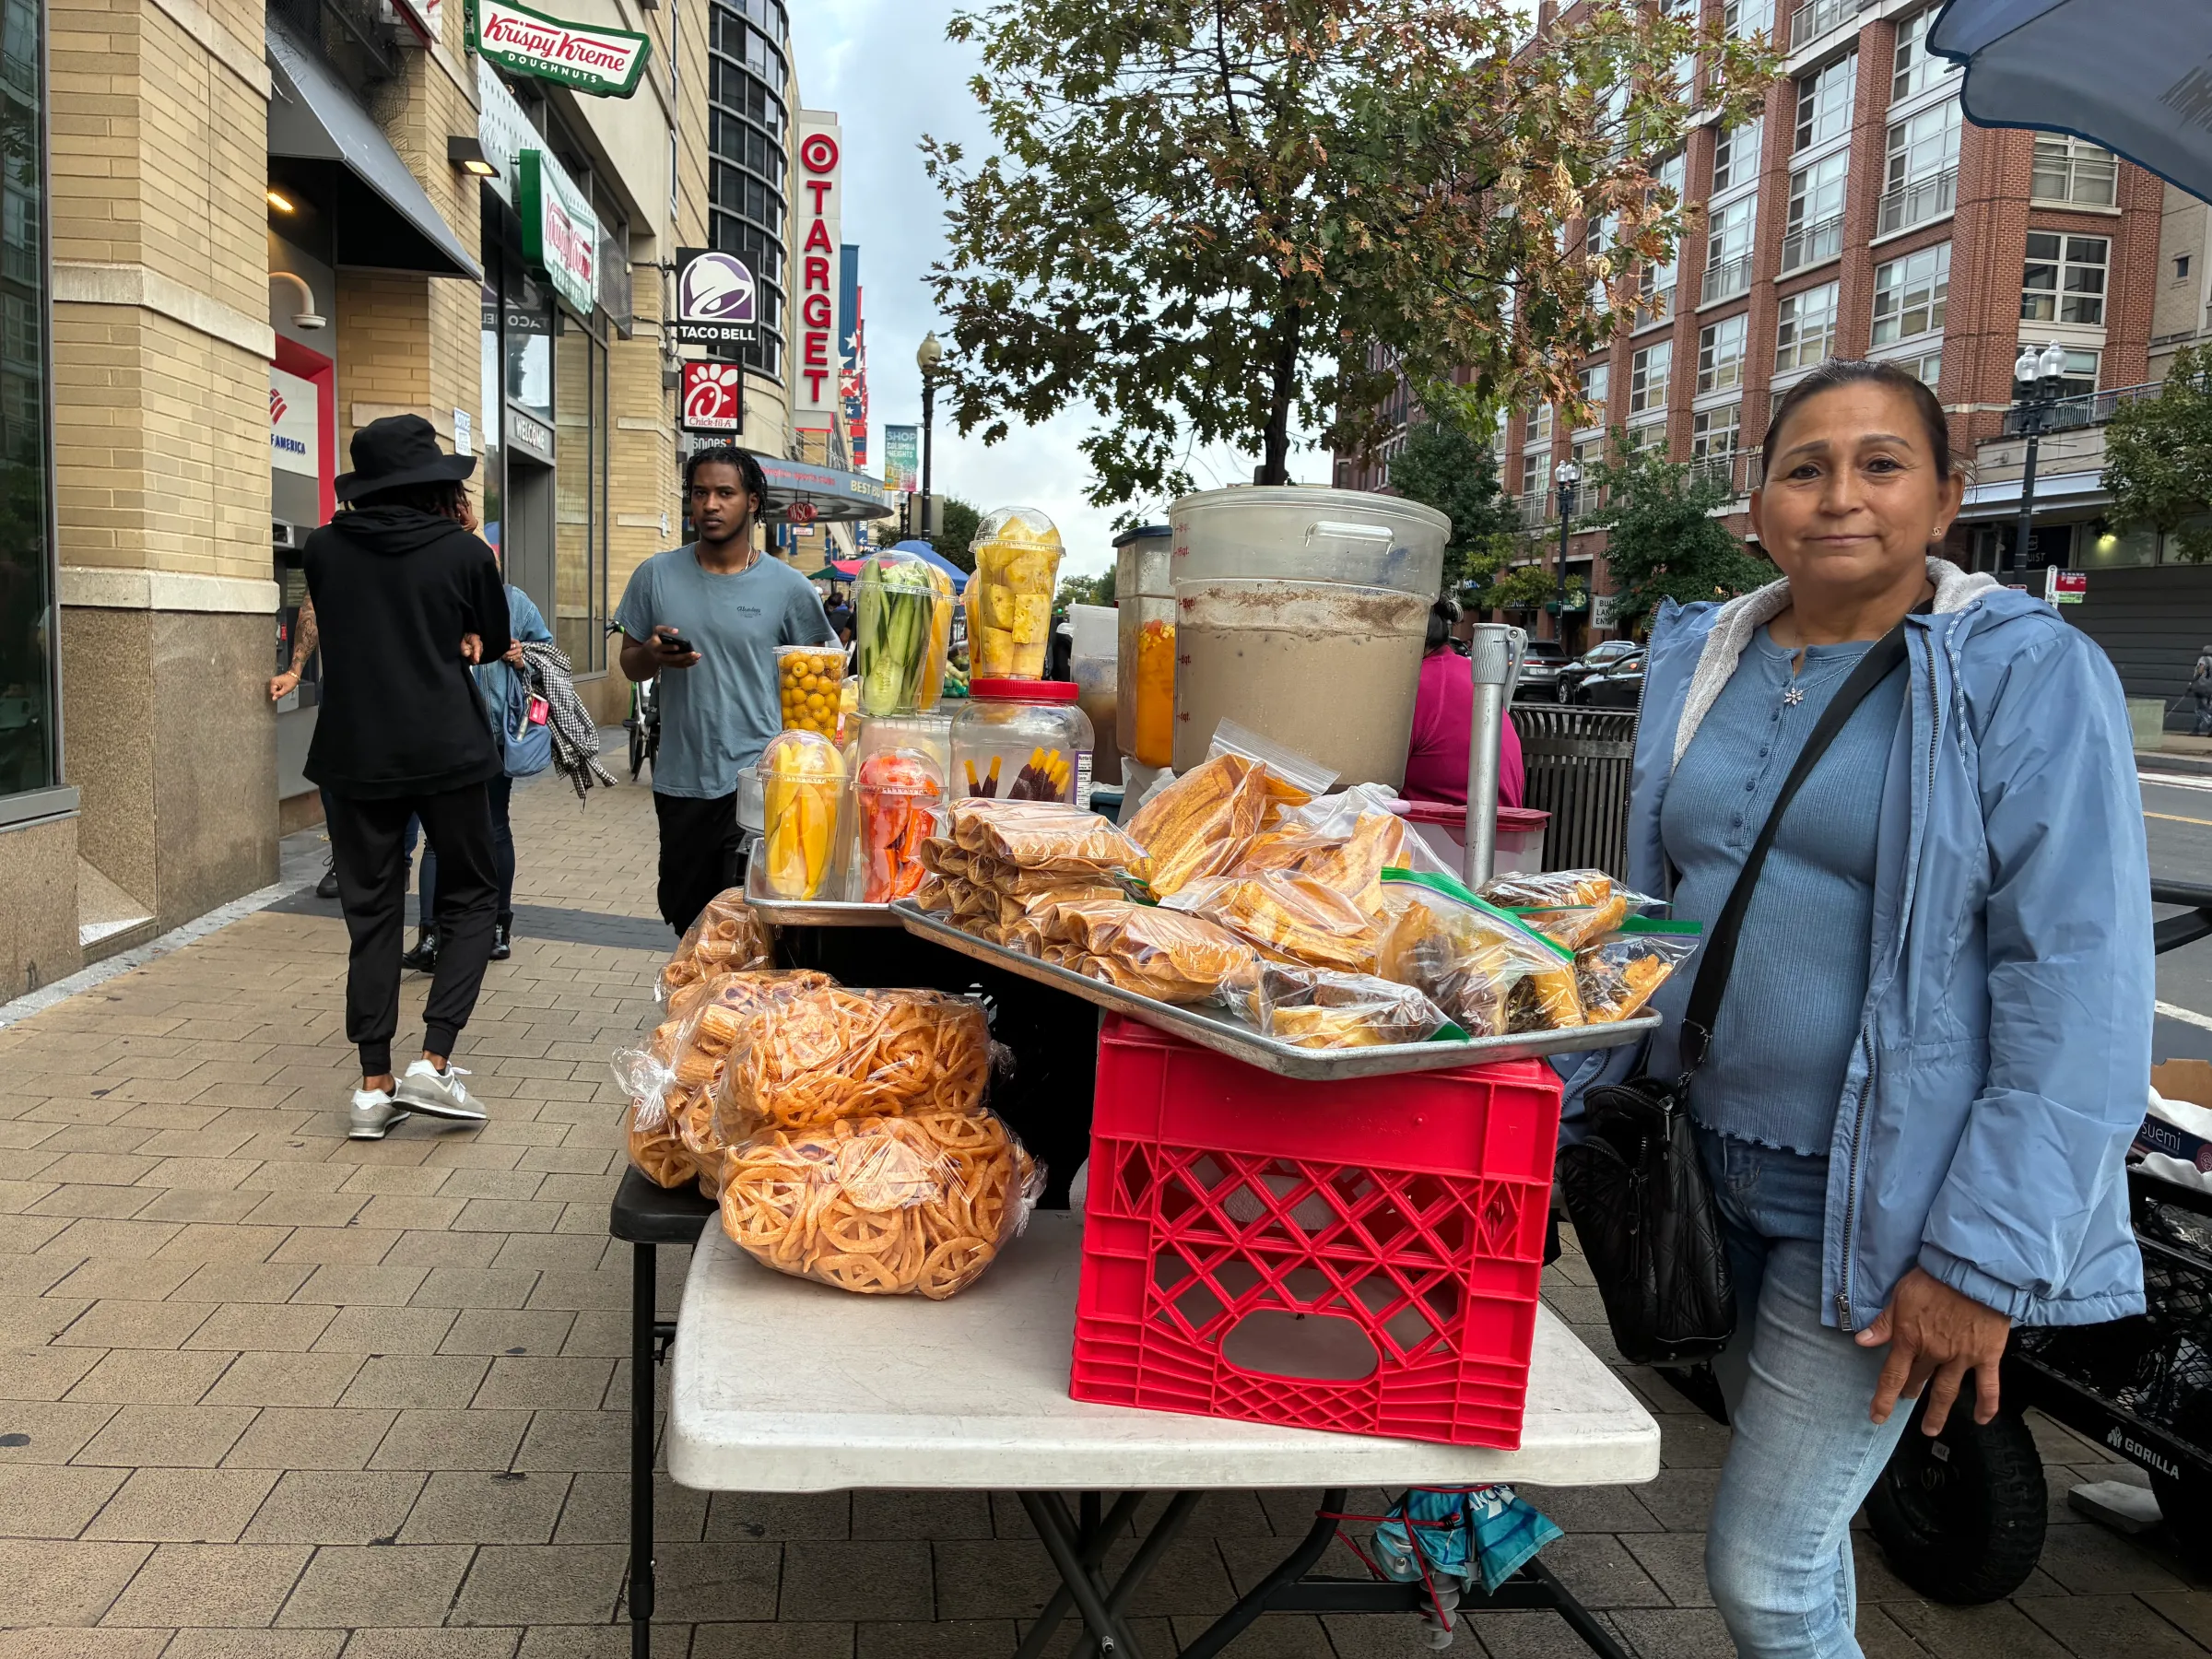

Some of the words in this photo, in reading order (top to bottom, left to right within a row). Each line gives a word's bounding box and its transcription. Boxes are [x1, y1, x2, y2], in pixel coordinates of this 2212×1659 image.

[483, 12, 561, 58] Krispy
[555, 31, 631, 72] Kreme
[508, 53, 597, 84] DOUGHNUTS
[804, 180, 832, 402] TARGET
[679, 326, 719, 339] TACO
[721, 328, 756, 341] BELL
[689, 417, 732, 428] Chick-fil-A
[515, 417, 545, 450] WELCOME
[887, 431, 916, 441] SHOP
[275, 435, 305, 454] AMERICA
[888, 450, 913, 458] HEIGHTS
[850, 479, 871, 494] BEST
[790, 503, 809, 521] WSC
[2028, 553, 2045, 562] UIST
[2124, 1437, 2179, 1480] GORILLA
